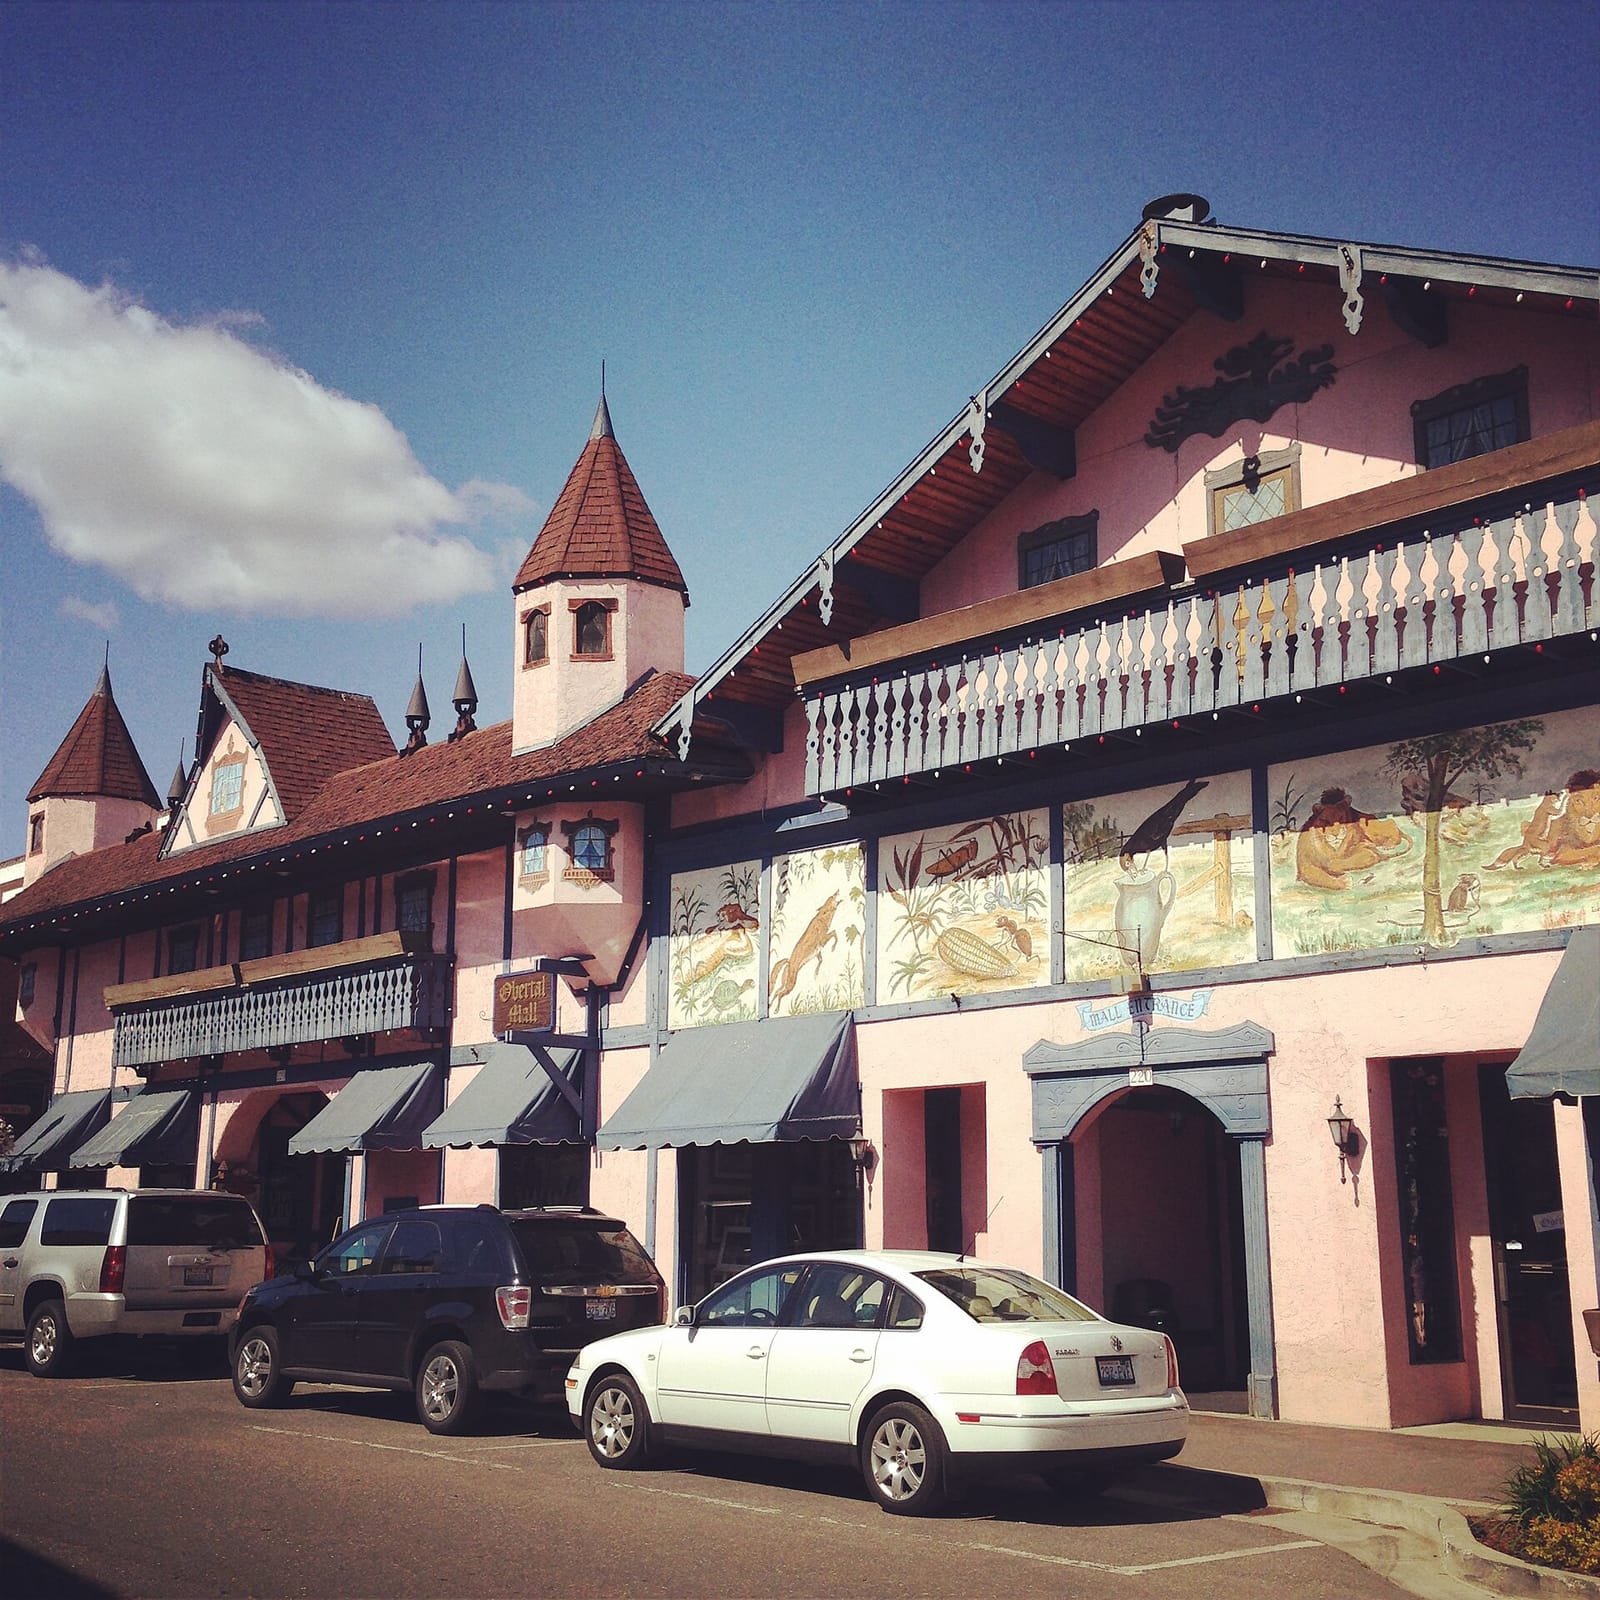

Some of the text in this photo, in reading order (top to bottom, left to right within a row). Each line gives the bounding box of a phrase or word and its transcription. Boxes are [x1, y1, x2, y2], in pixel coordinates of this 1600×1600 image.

[500, 976, 546, 1002] Obertal
[508, 1002, 538, 1025] Mall
[1089, 997, 1195, 1027] MALL ENTRANCE
[1130, 1069, 1152, 1084] 220
